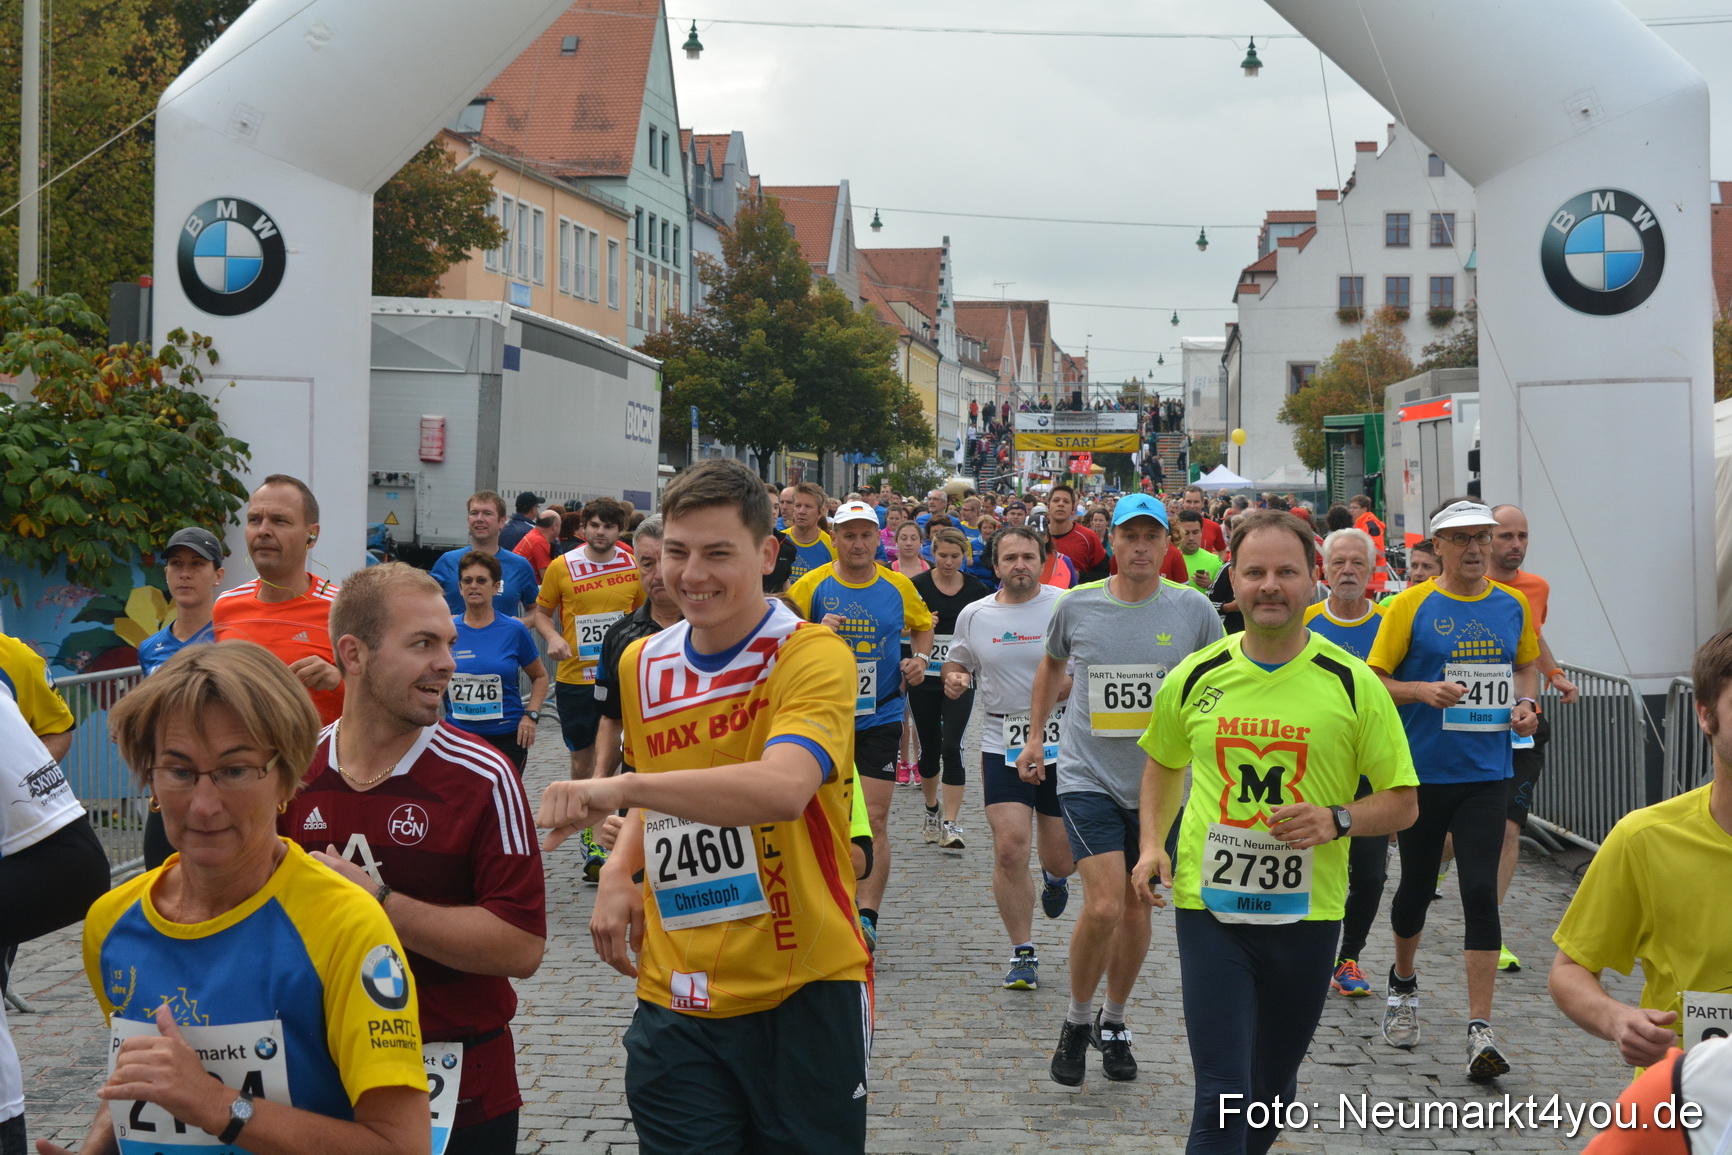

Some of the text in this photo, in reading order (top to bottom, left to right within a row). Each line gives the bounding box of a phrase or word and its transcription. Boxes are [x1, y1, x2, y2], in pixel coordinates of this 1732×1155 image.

[185, 200, 277, 240] BMW
[1551, 192, 1656, 235] BMW
[1055, 437, 1098, 447] START
[573, 573, 638, 594] MAX BÖGL
[1089, 671, 1154, 679] PARTL Neumarkt
[453, 683, 498, 702] 2746
[1104, 682, 1153, 709] 653
[464, 705, 487, 714] Karola
[1469, 711, 1493, 722] Hans
[1215, 716, 1311, 740] Müller
[646, 721, 701, 758] MAX
[1237, 763, 1286, 805] M
[404, 806, 414, 821] 1.
[303, 822, 327, 830] adidas
[391, 819, 424, 838] FCN
[646, 817, 677, 833] PARTL
[1208, 832, 1291, 851] PARTL Neumark
[655, 826, 745, 883] 2460
[1211, 849, 1304, 890] 2738
[674, 883, 740, 911] Christoph
[1236, 896, 1272, 912] Mike
[366, 946, 404, 970] BMW
[113, 970, 123, 979] 15
[111, 985, 127, 995] ahre
[367, 1018, 416, 1038] PARTL
[370, 1036, 417, 1051] Neumarkt
